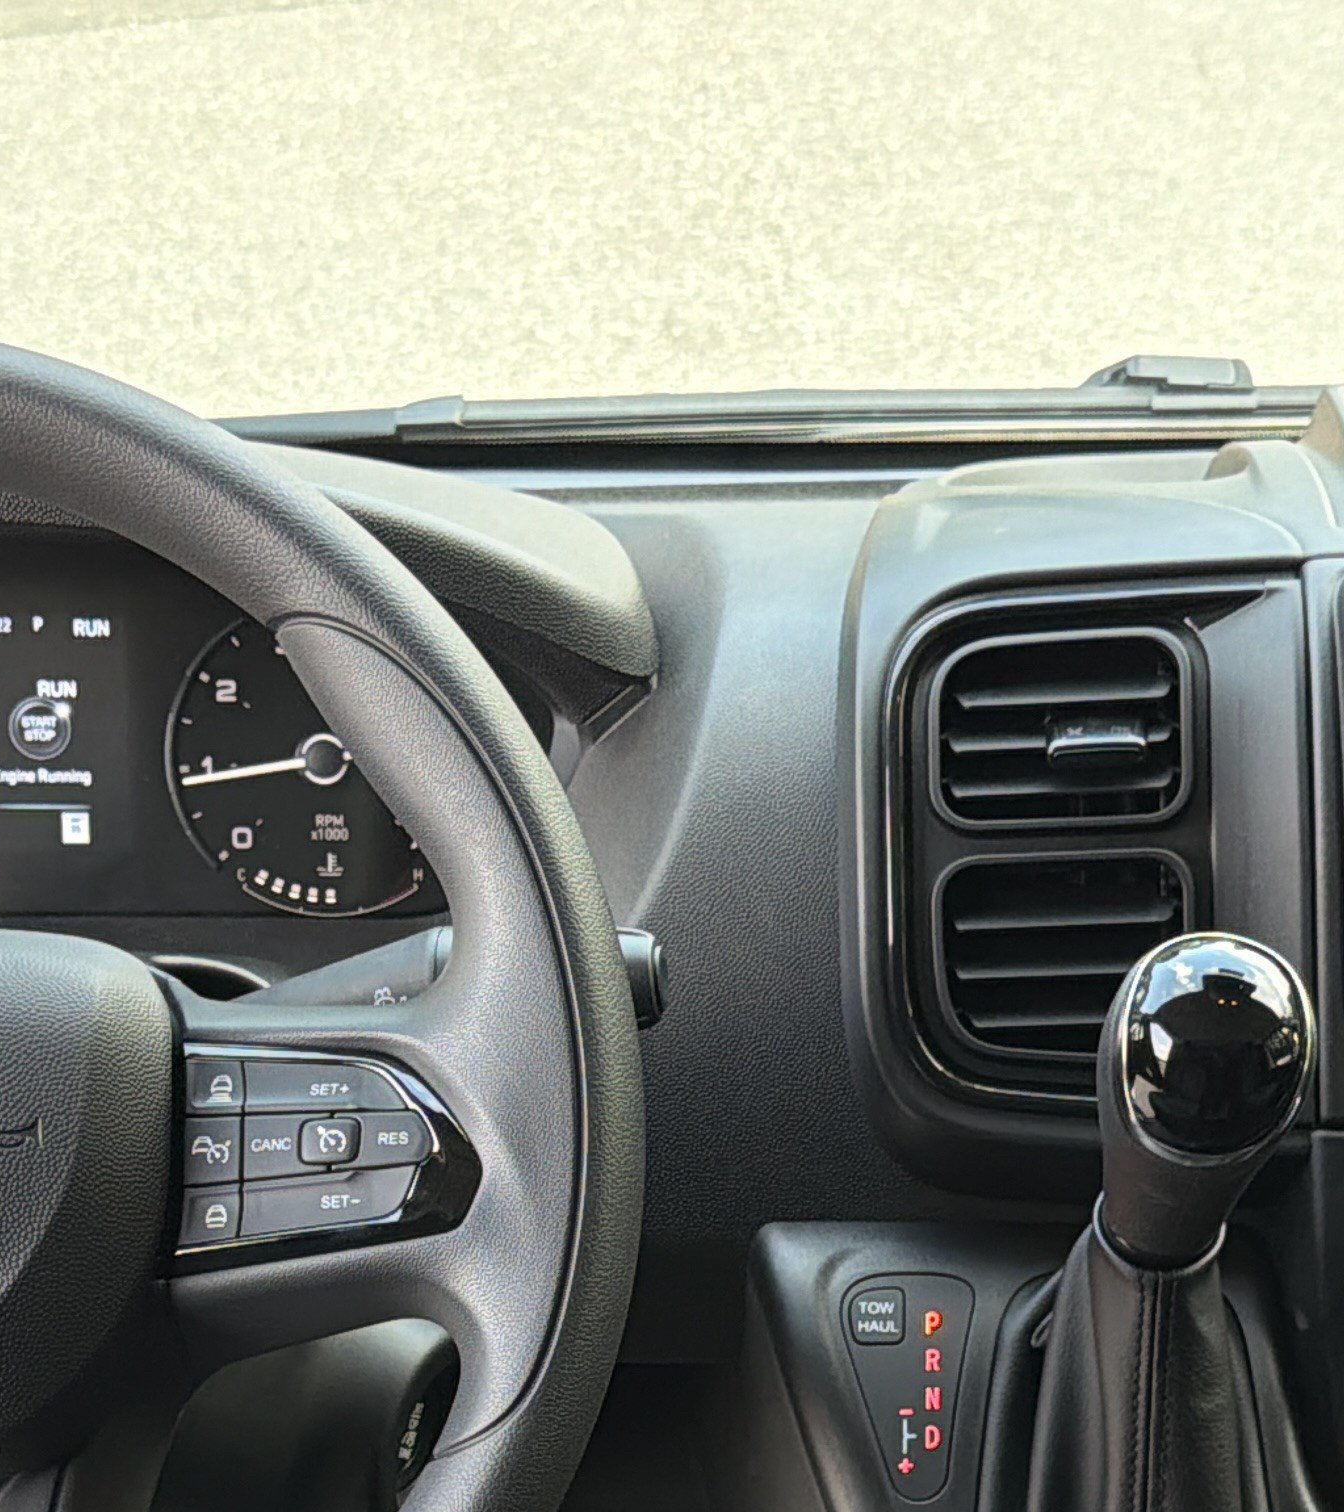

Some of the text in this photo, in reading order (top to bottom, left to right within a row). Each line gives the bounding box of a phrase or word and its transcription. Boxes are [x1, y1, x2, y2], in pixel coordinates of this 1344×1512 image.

[32, 615, 44, 632] P
[72, 618, 110, 637] RUN
[36, 679, 77, 698] RUN
[215, 679, 237, 702] 2
[21, 715, 56, 728] START
[23, 729, 56, 741] STOP
[201, 756, 214, 774] 1
[37, 767, 92, 787] Running
[315, 814, 345, 827] RPM
[231, 826, 253, 850] 0
[311, 828, 349, 841] x1000
[236, 868, 246, 882] C
[412, 868, 423, 881] H
[309, 1083, 350, 1097] SET+
[251, 1138, 292, 1152] CANC
[378, 1132, 409, 1146] RES
[858, 1301, 895, 1316] TOW
[858, 1320, 899, 1334] HAUL
[924, 1310, 943, 1336] P
[924, 1348, 942, 1373] R
[924, 1386, 942, 1411] N
[924, 1424, 942, 1450] D
